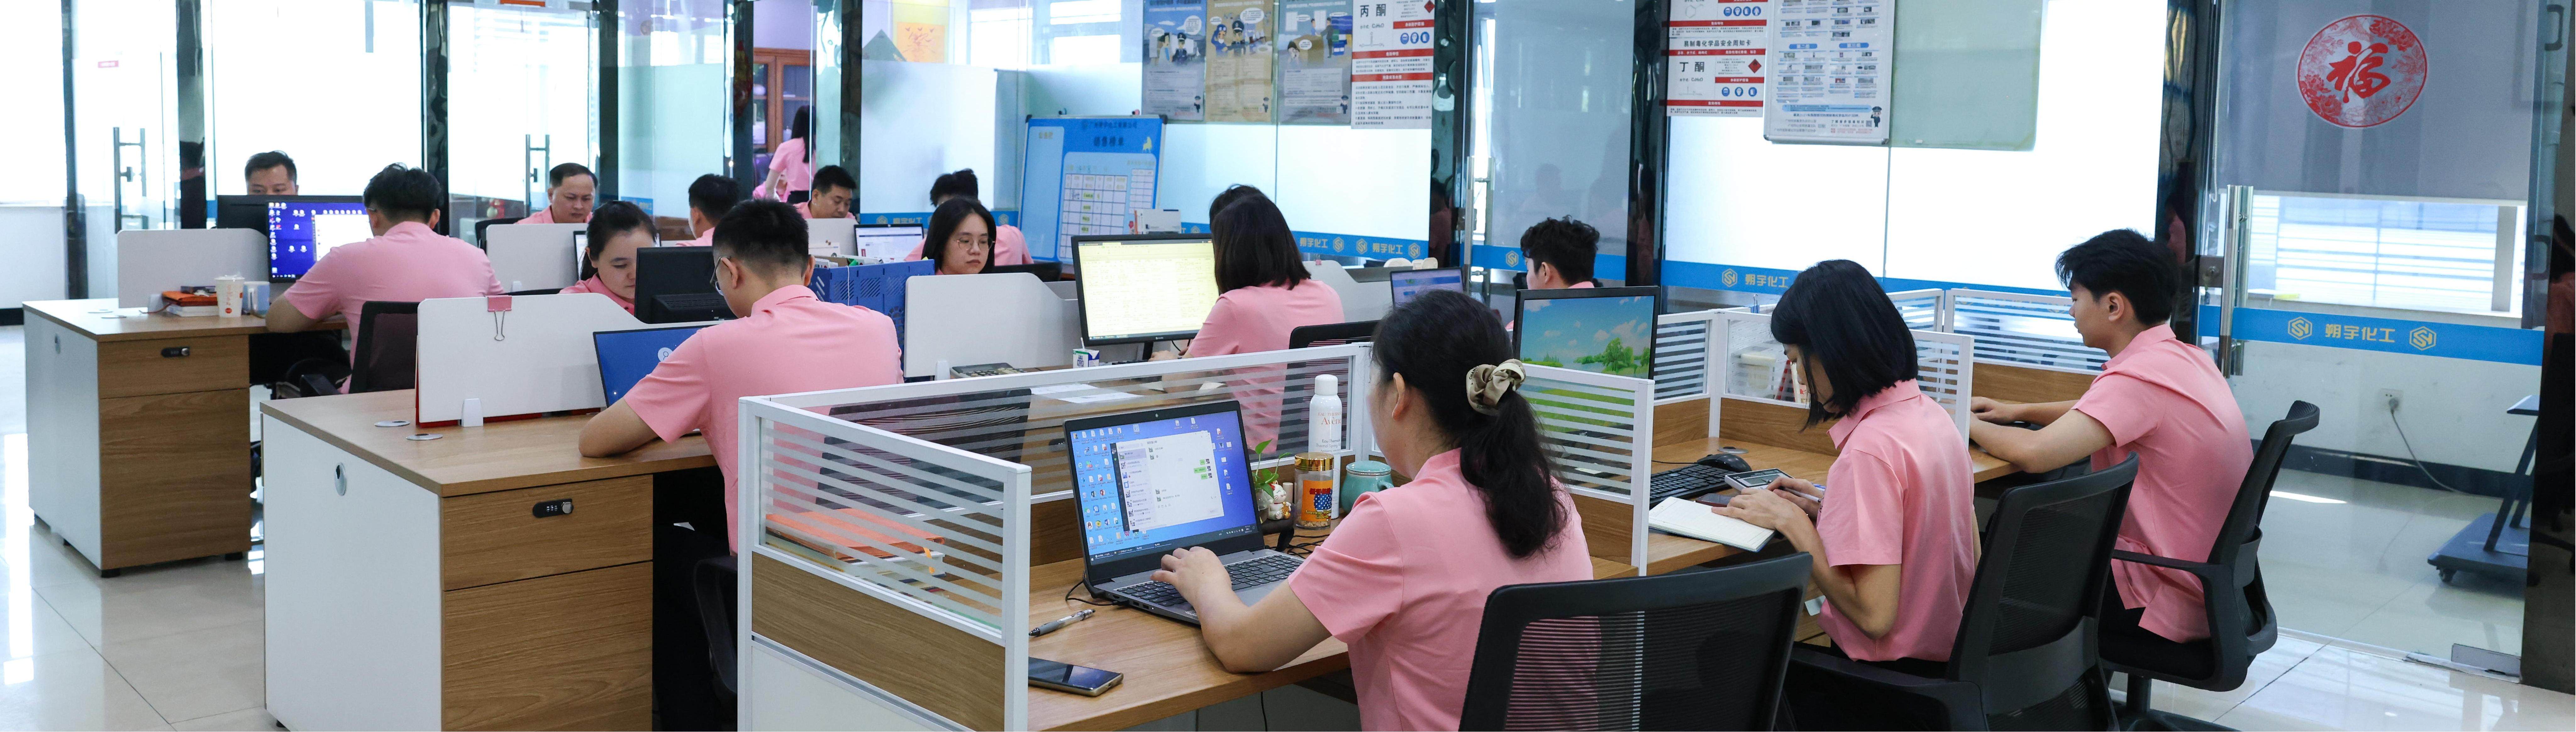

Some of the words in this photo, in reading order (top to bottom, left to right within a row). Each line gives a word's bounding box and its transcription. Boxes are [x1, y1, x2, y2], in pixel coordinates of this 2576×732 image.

[1360, 3, 1386, 18] 丙酮
[1679, 61, 1705, 73] 丁酮
[2326, 41, 2391, 104] 福
[1745, 274, 1789, 288] 朔宇化工
[2325, 323, 2396, 343] 朔宇化工
